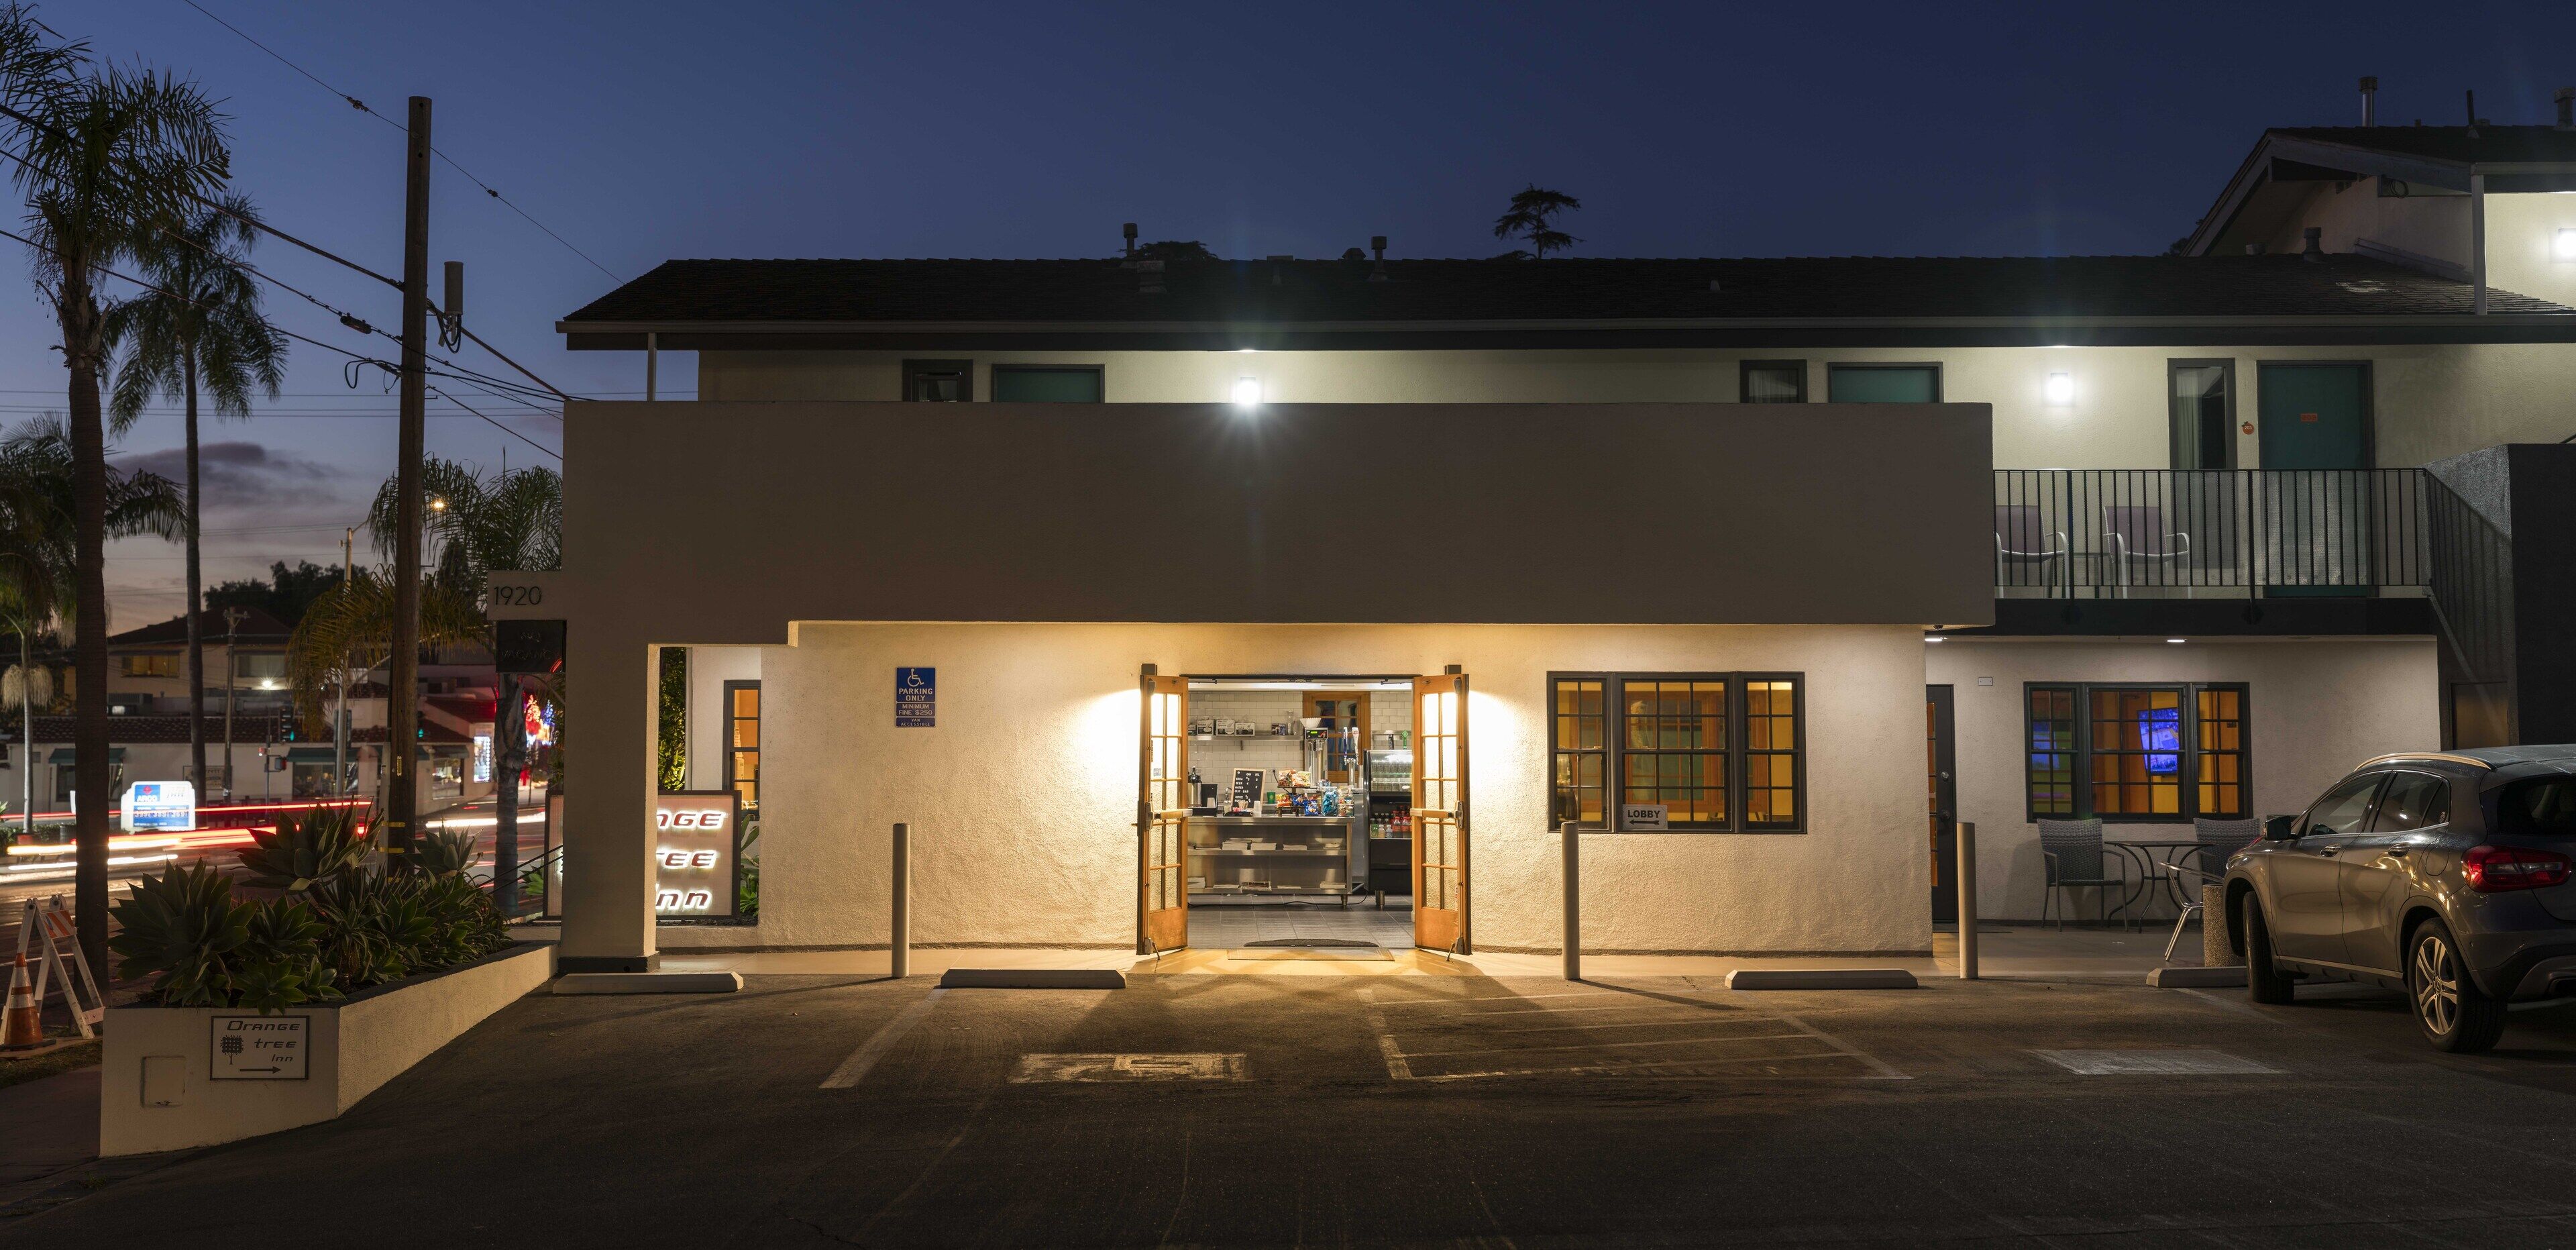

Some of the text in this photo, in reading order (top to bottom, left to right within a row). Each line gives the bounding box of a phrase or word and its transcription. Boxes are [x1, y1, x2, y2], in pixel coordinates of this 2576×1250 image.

[494, 586, 541, 605] 1920
[1627, 809, 1661, 819] LOBBY
[271, 1053, 293, 1062] Inn
